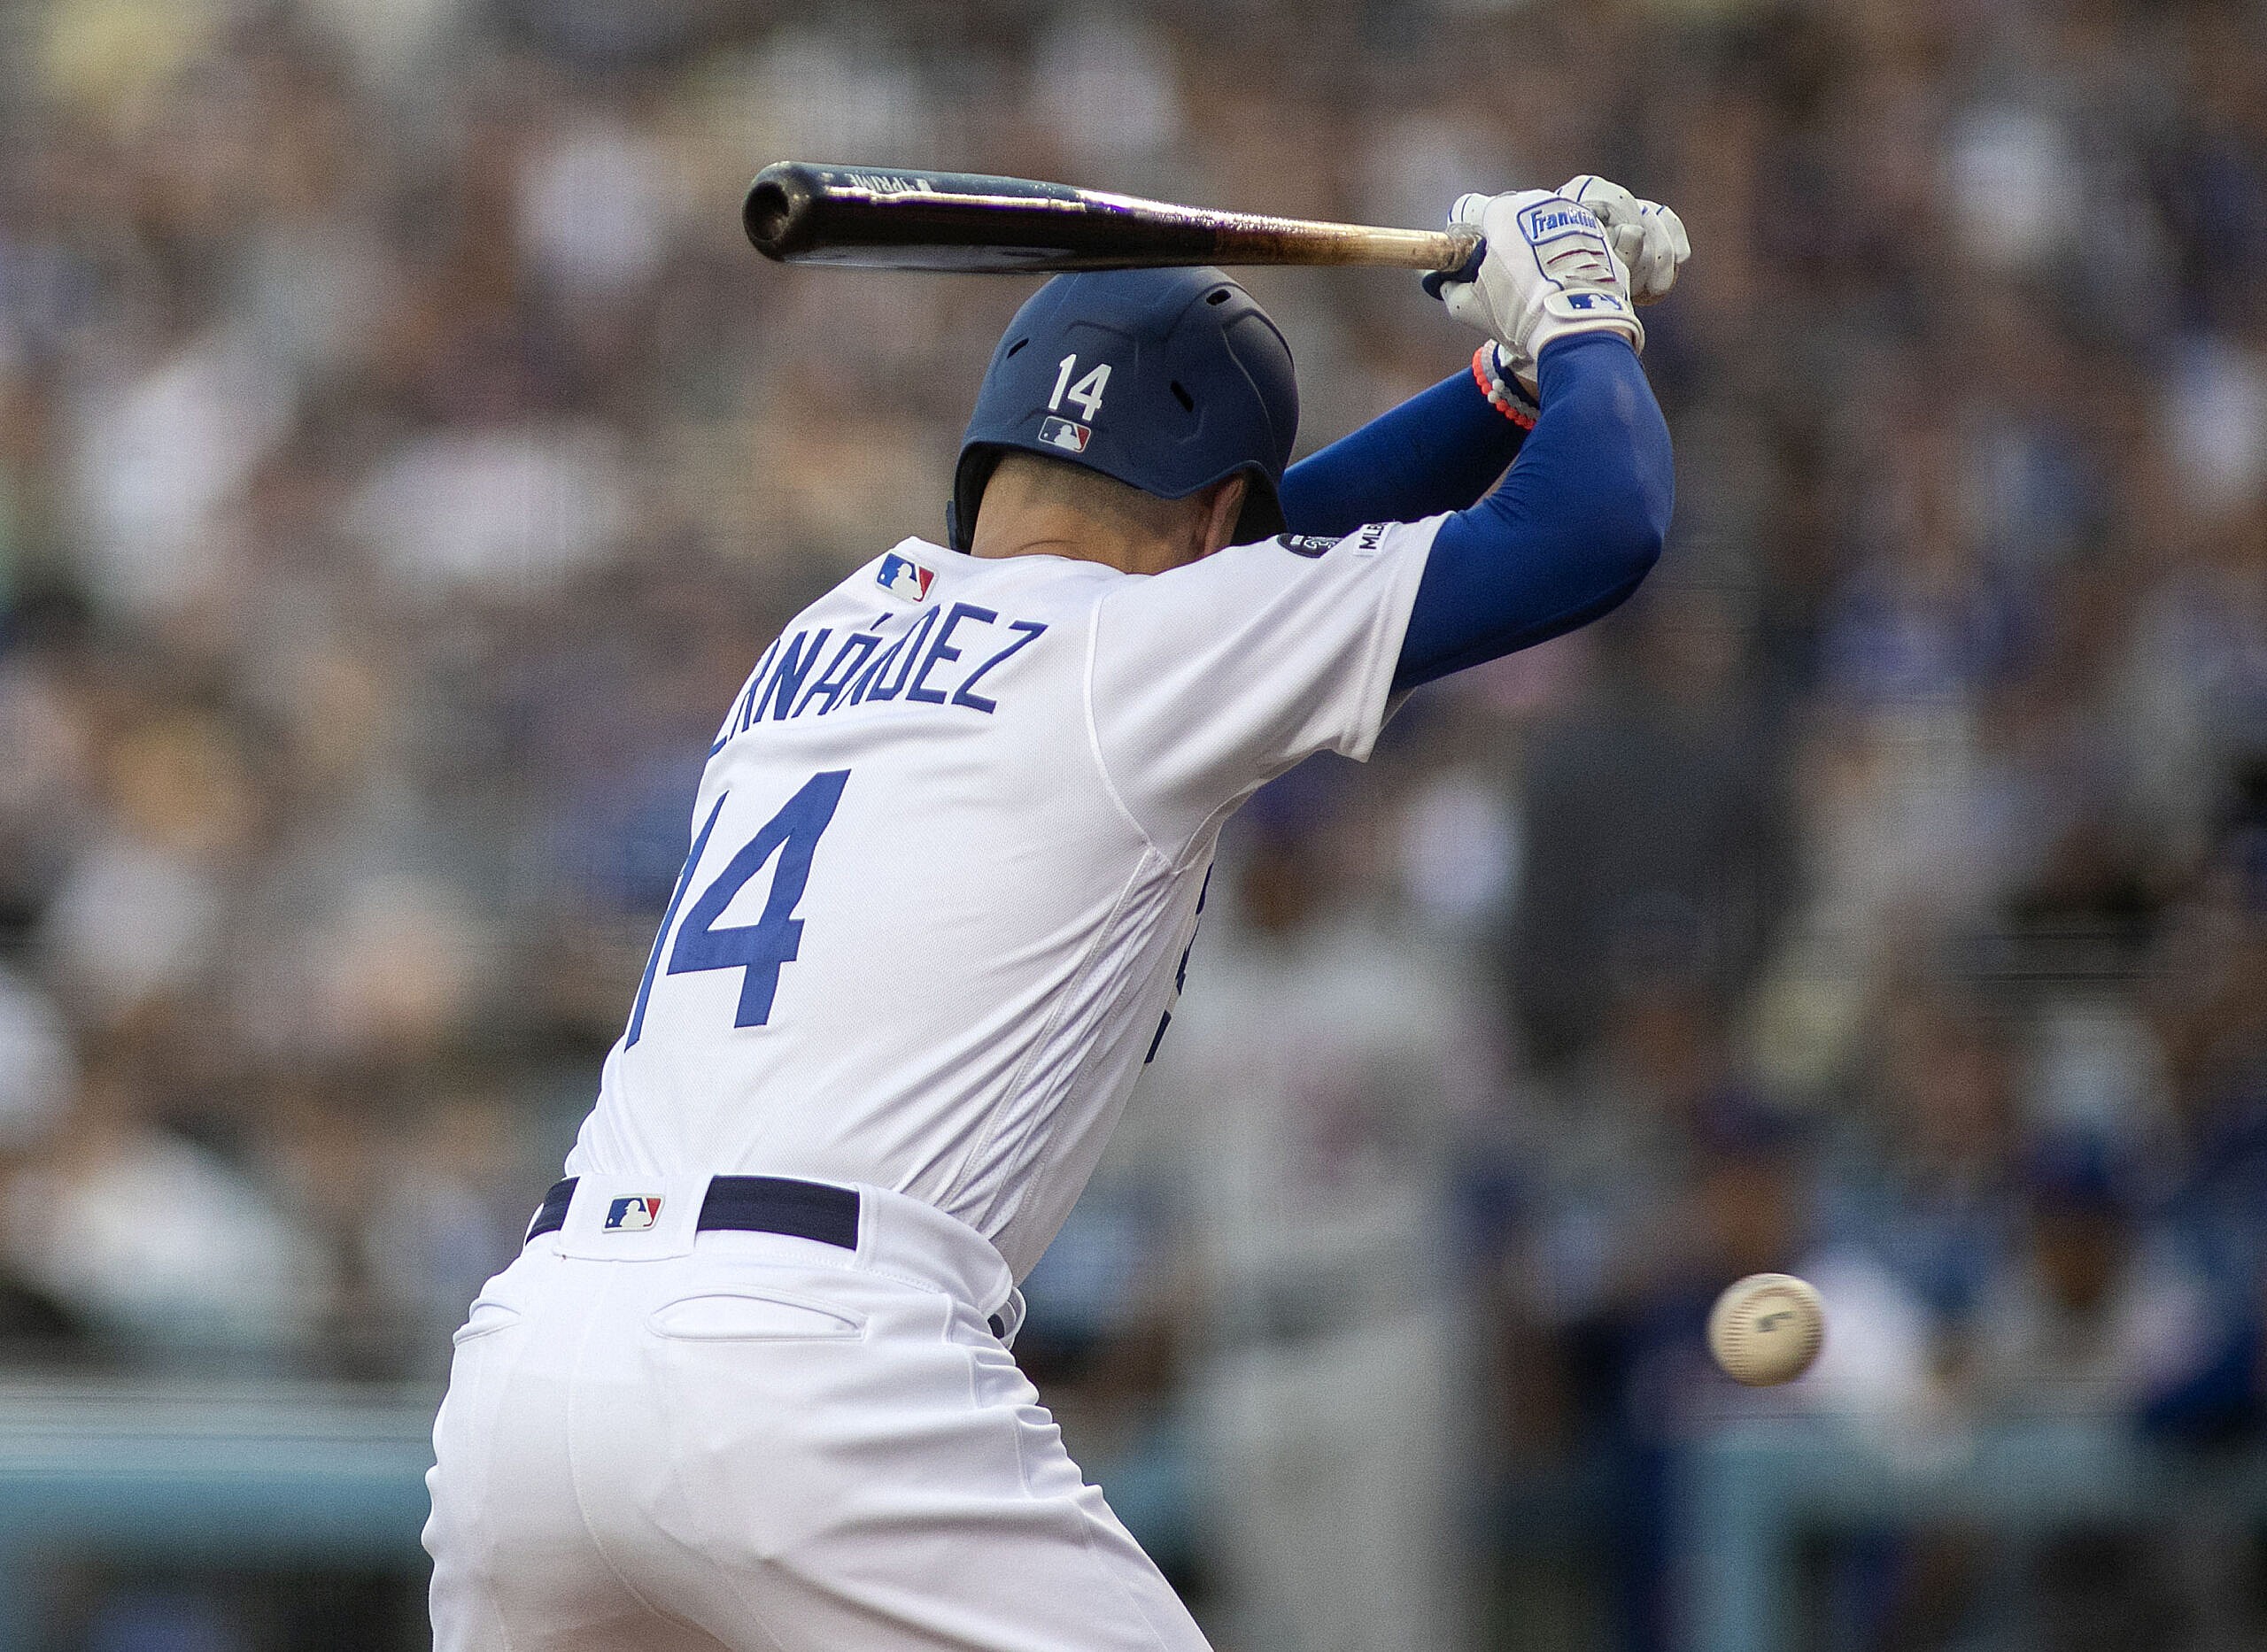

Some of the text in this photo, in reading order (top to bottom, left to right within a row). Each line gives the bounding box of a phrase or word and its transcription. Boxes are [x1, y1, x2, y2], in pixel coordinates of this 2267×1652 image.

[1529, 205, 1598, 239] Franklin
[1048, 353, 1112, 421] 14
[623, 768, 853, 1054] 14
